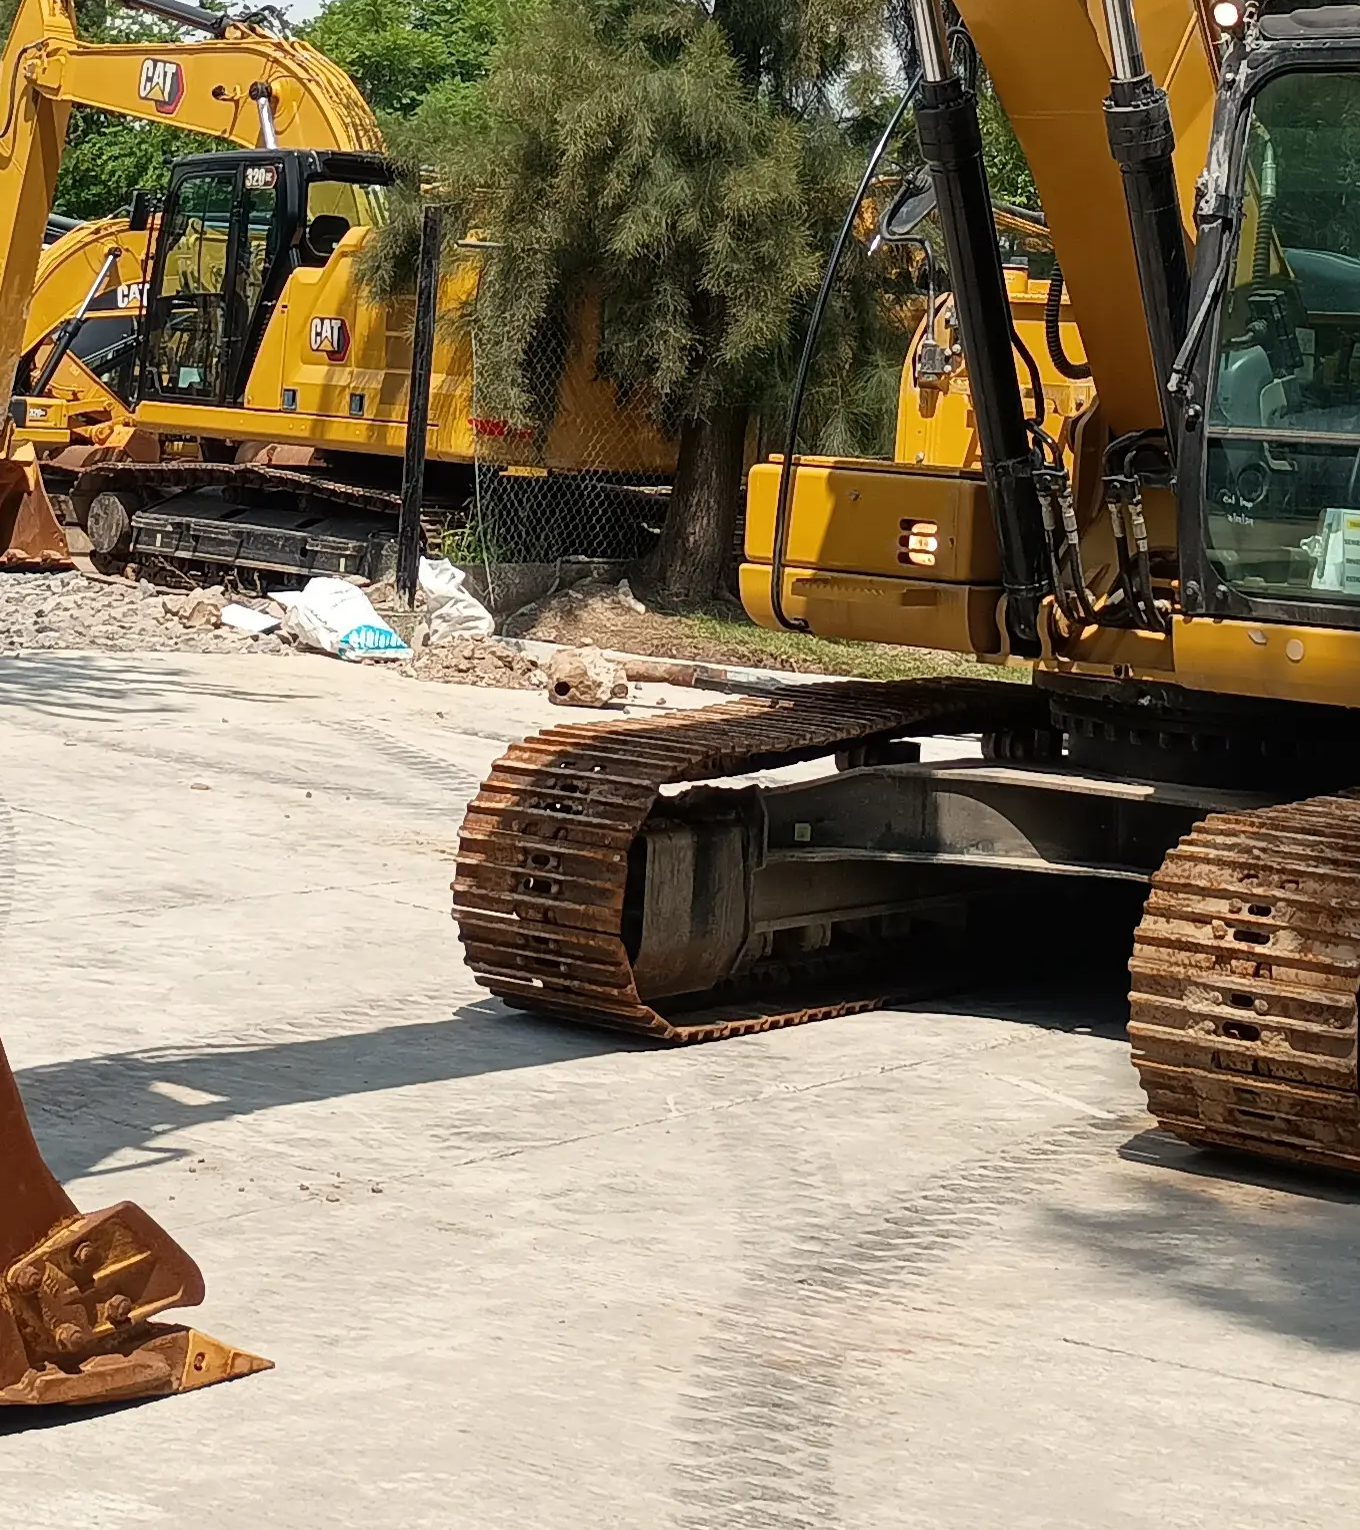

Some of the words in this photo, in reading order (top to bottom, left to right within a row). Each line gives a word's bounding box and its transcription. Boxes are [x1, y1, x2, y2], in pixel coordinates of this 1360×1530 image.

[139, 58, 177, 102] CAT
[245, 168, 265, 186] 320
[117, 283, 150, 308] CAT
[310, 317, 342, 351] CAT
